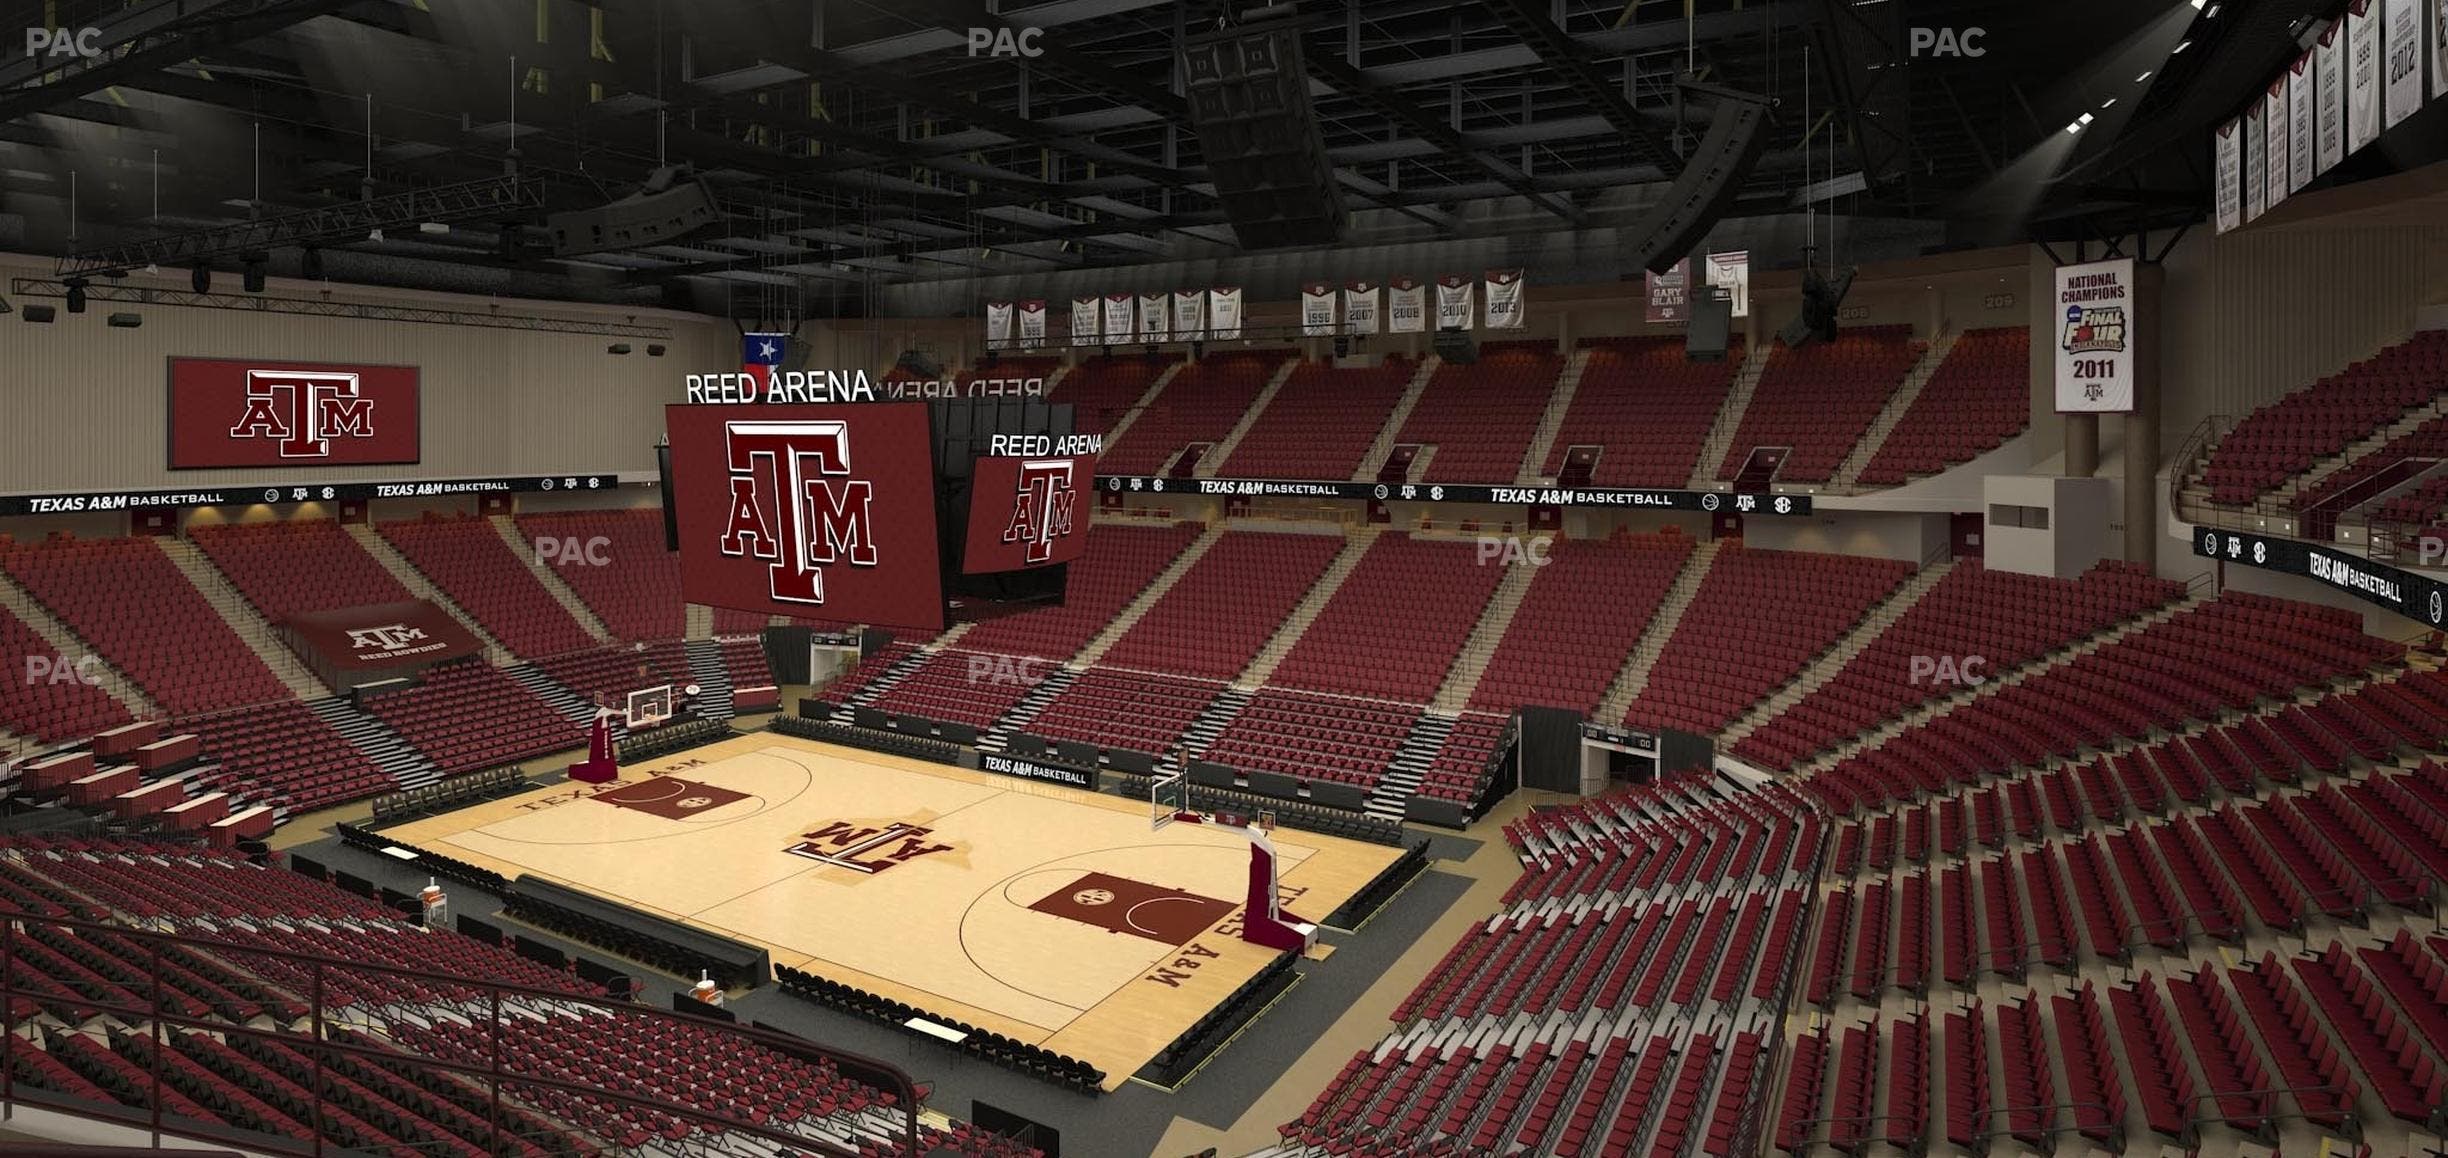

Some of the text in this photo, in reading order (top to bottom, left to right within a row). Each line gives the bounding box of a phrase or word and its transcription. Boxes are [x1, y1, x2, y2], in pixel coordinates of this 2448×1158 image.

[2391, 40, 2415, 86] 2012
[2068, 272, 2117, 289] NATIONAL
[1654, 288, 1681, 298] GARY
[2062, 285, 2125, 303] CHAMPIONS
[1443, 303, 1467, 317] 2010
[1491, 302, 1516, 315] 2013
[1652, 297, 1684, 307] BLAIR
[1350, 309, 1374, 321] 2007
[2073, 359, 2114, 378] 2011
[686, 369, 875, 404] REED ARENA
[990, 433, 1102, 457] REED ARENA
[377, 481, 509, 497] TEXAS A&M BASKETBALL
[1200, 481, 1339, 495] TEXAS A&M BASKETBALL
[1491, 488, 1672, 505] TEXAS A&M BASKETBALL
[30, 493, 224, 513] TEXAS A&M BASKETBALL
[2309, 552, 2402, 602] TEXAS A&M BASKETBALL
[358, 649, 393, 660] REED
[985, 756, 1086, 784] TEXAS A&M BASKETBALL
[1146, 943, 1220, 988] A&M
